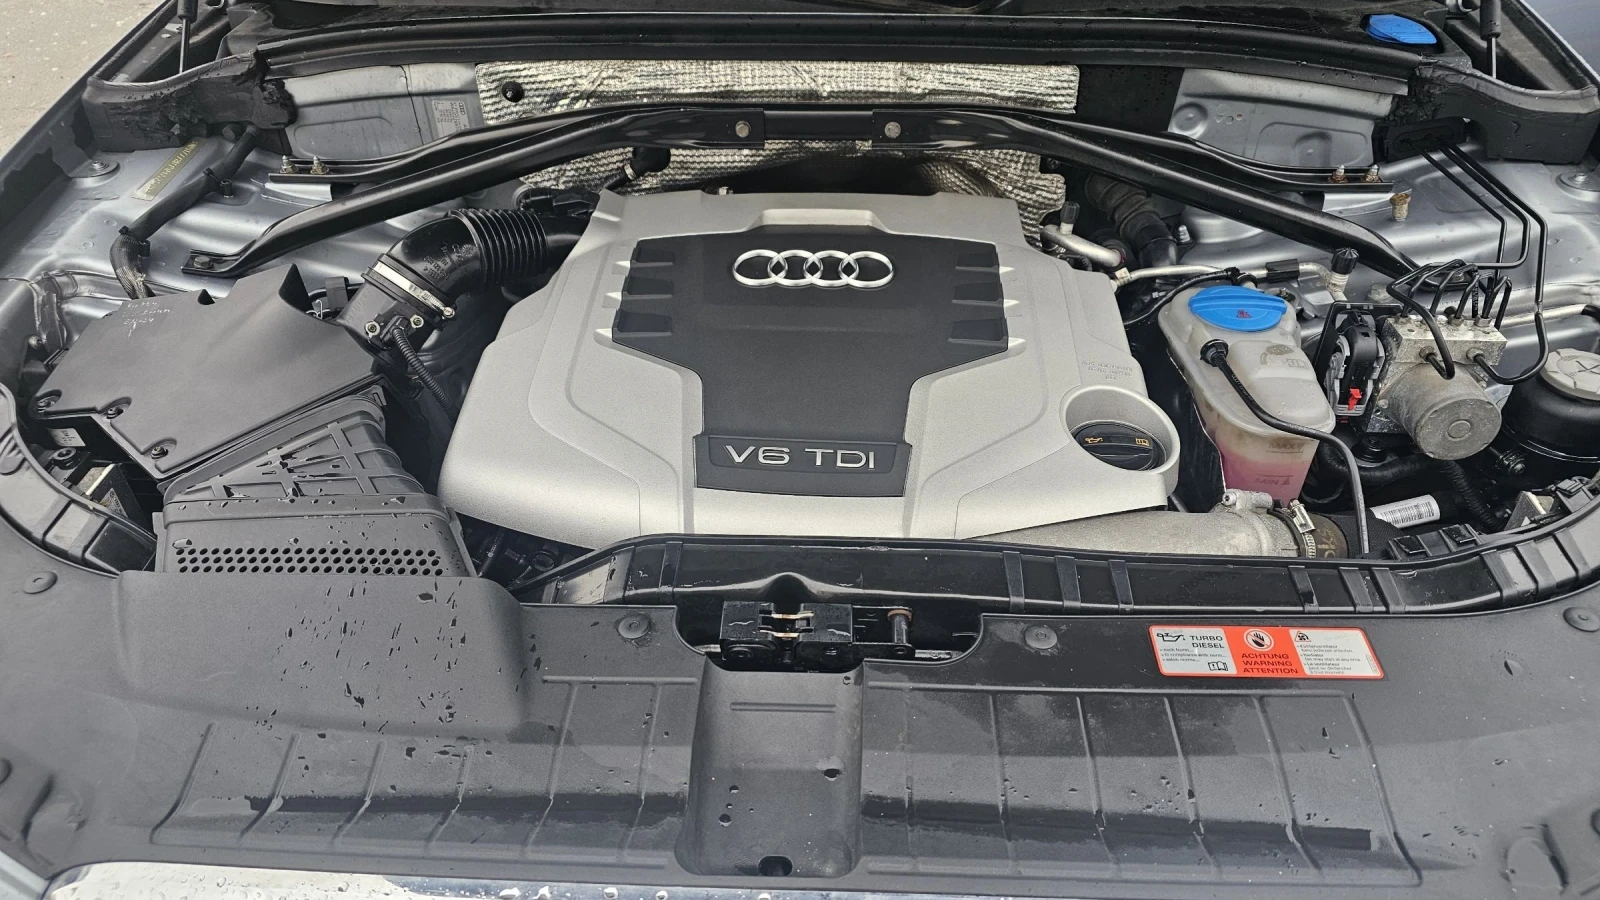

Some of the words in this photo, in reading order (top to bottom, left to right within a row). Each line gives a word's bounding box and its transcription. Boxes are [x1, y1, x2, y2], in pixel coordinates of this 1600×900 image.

[1269, 442, 1296, 450] MAX
[725, 445, 791, 465] V6
[804, 448, 875, 470] TDI
[1255, 478, 1279, 486] MIN
[1243, 667, 1298, 675] ATTENTION
